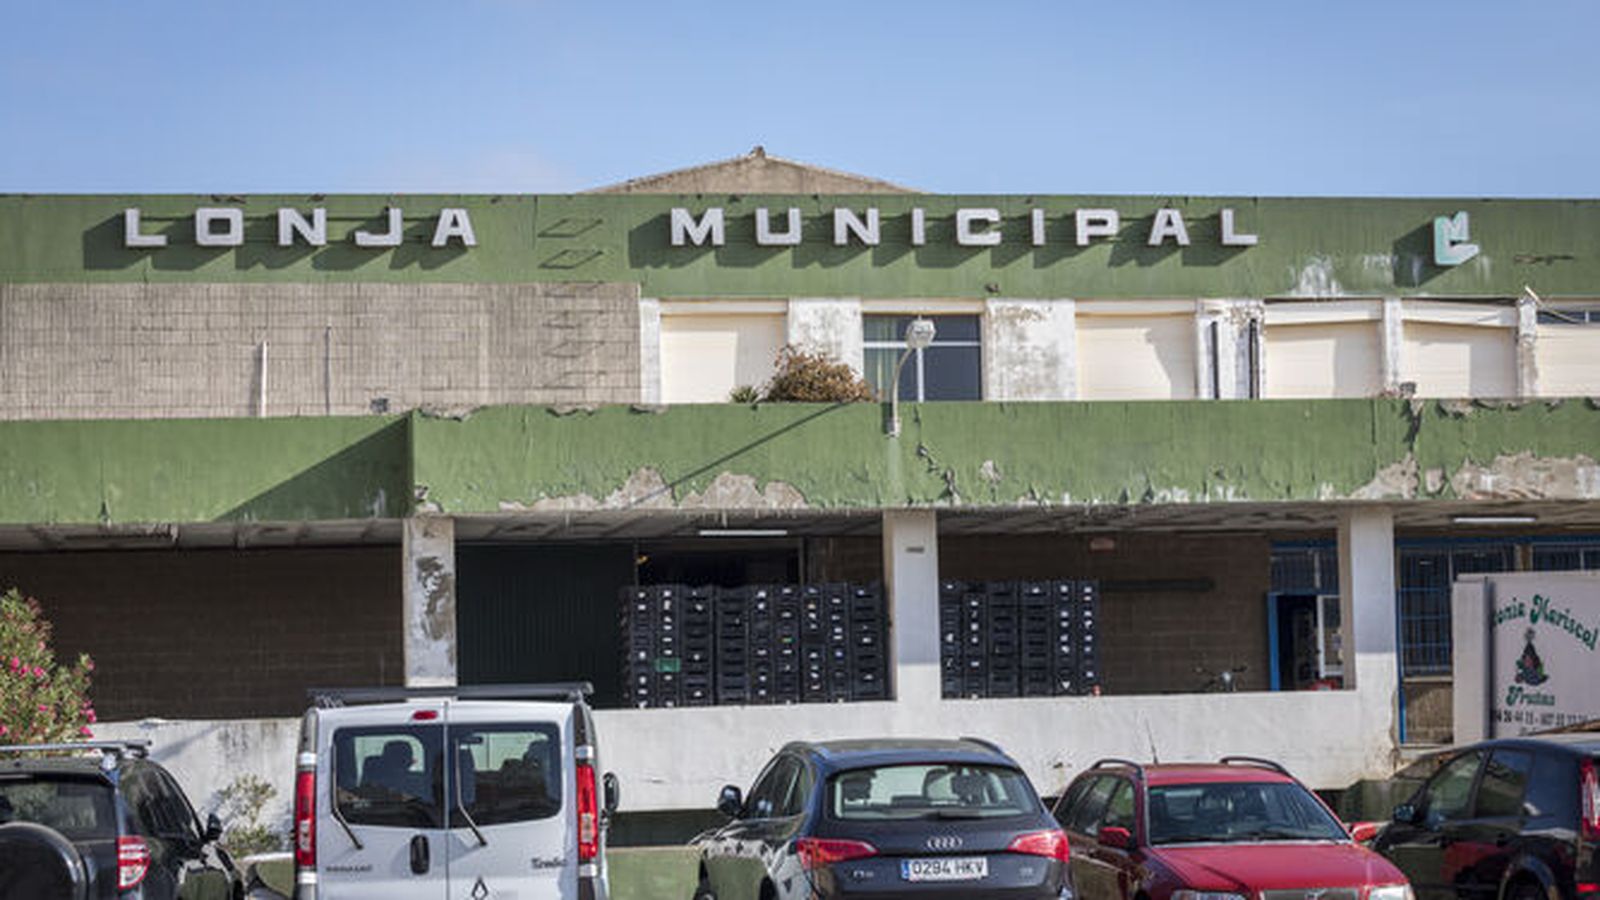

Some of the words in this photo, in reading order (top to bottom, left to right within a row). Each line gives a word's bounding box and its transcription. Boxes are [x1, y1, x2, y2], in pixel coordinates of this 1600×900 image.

[124, 208, 478, 247] LONJA
[670, 207, 1258, 247] MUNICIPAL
[955, 860, 983, 874] HKV
